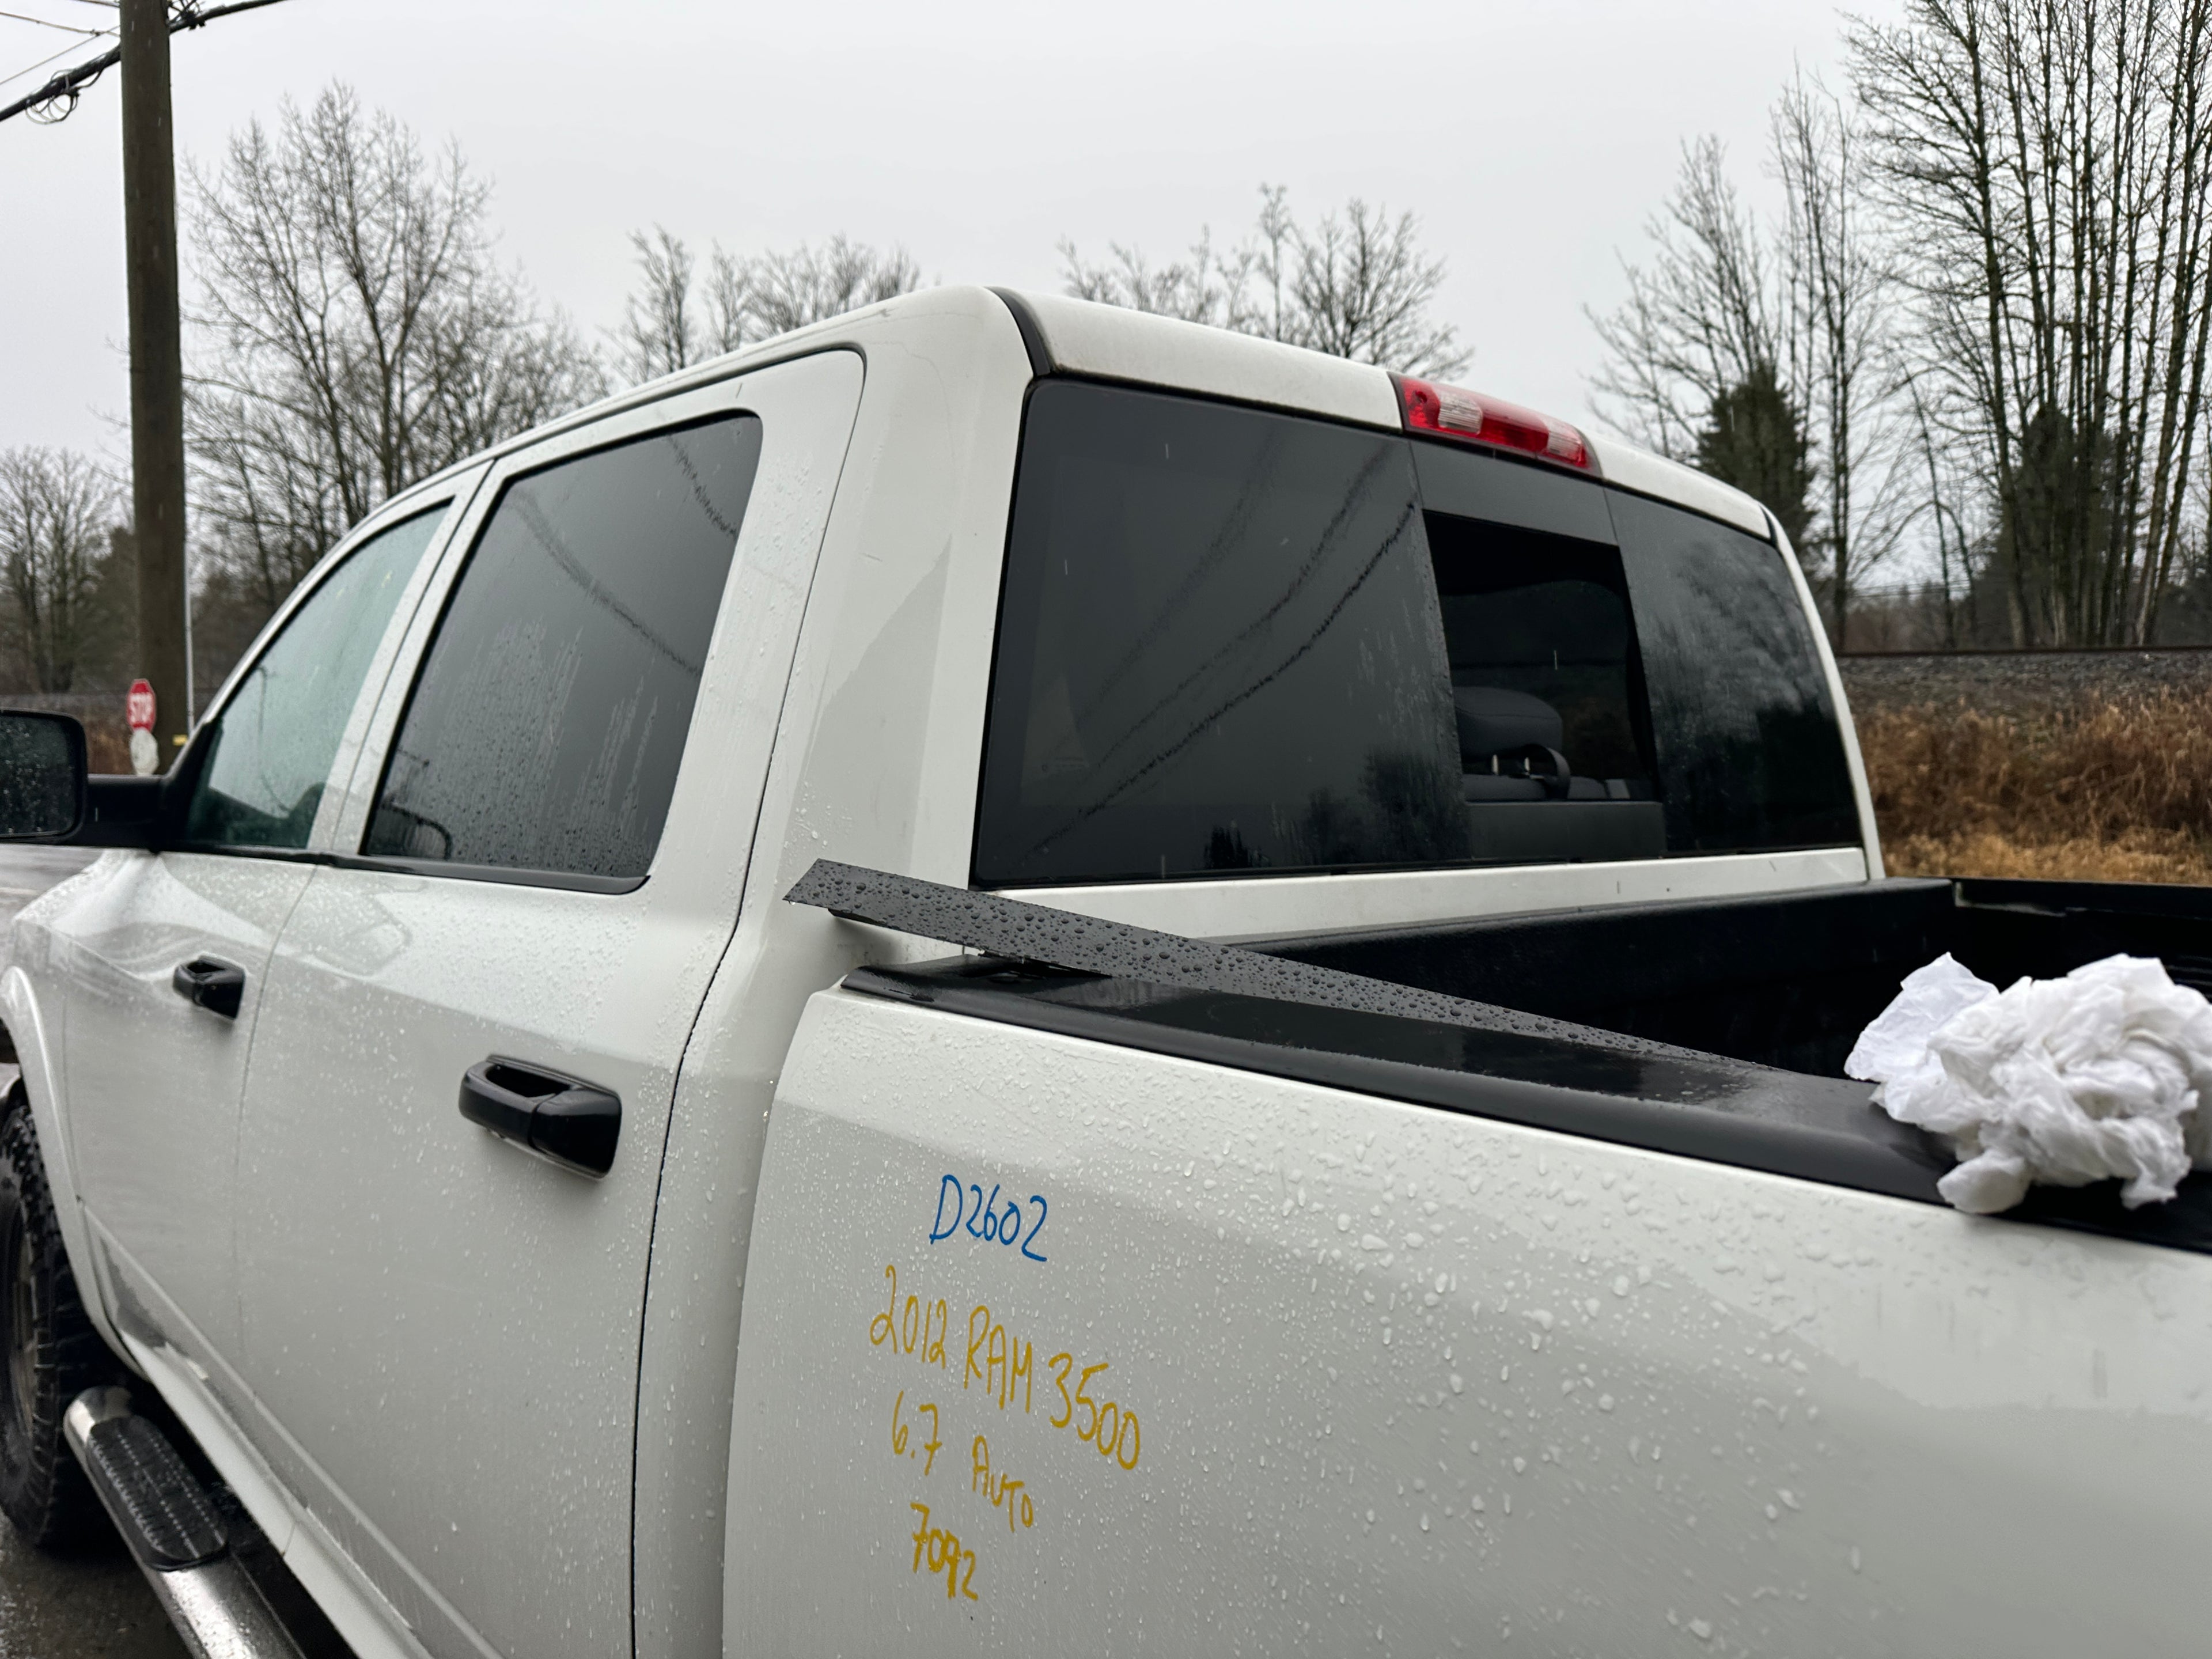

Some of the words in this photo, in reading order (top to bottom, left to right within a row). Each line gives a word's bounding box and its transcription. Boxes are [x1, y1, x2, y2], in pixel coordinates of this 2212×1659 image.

[929, 1174, 1047, 1262] D2602
[870, 1264, 948, 1369] 2012
[964, 1305, 1033, 1414] RAM
[1048, 1353, 1141, 1471] 3500
[892, 1390, 942, 1476] 6.7
[910, 1502, 979, 1601] 7092
